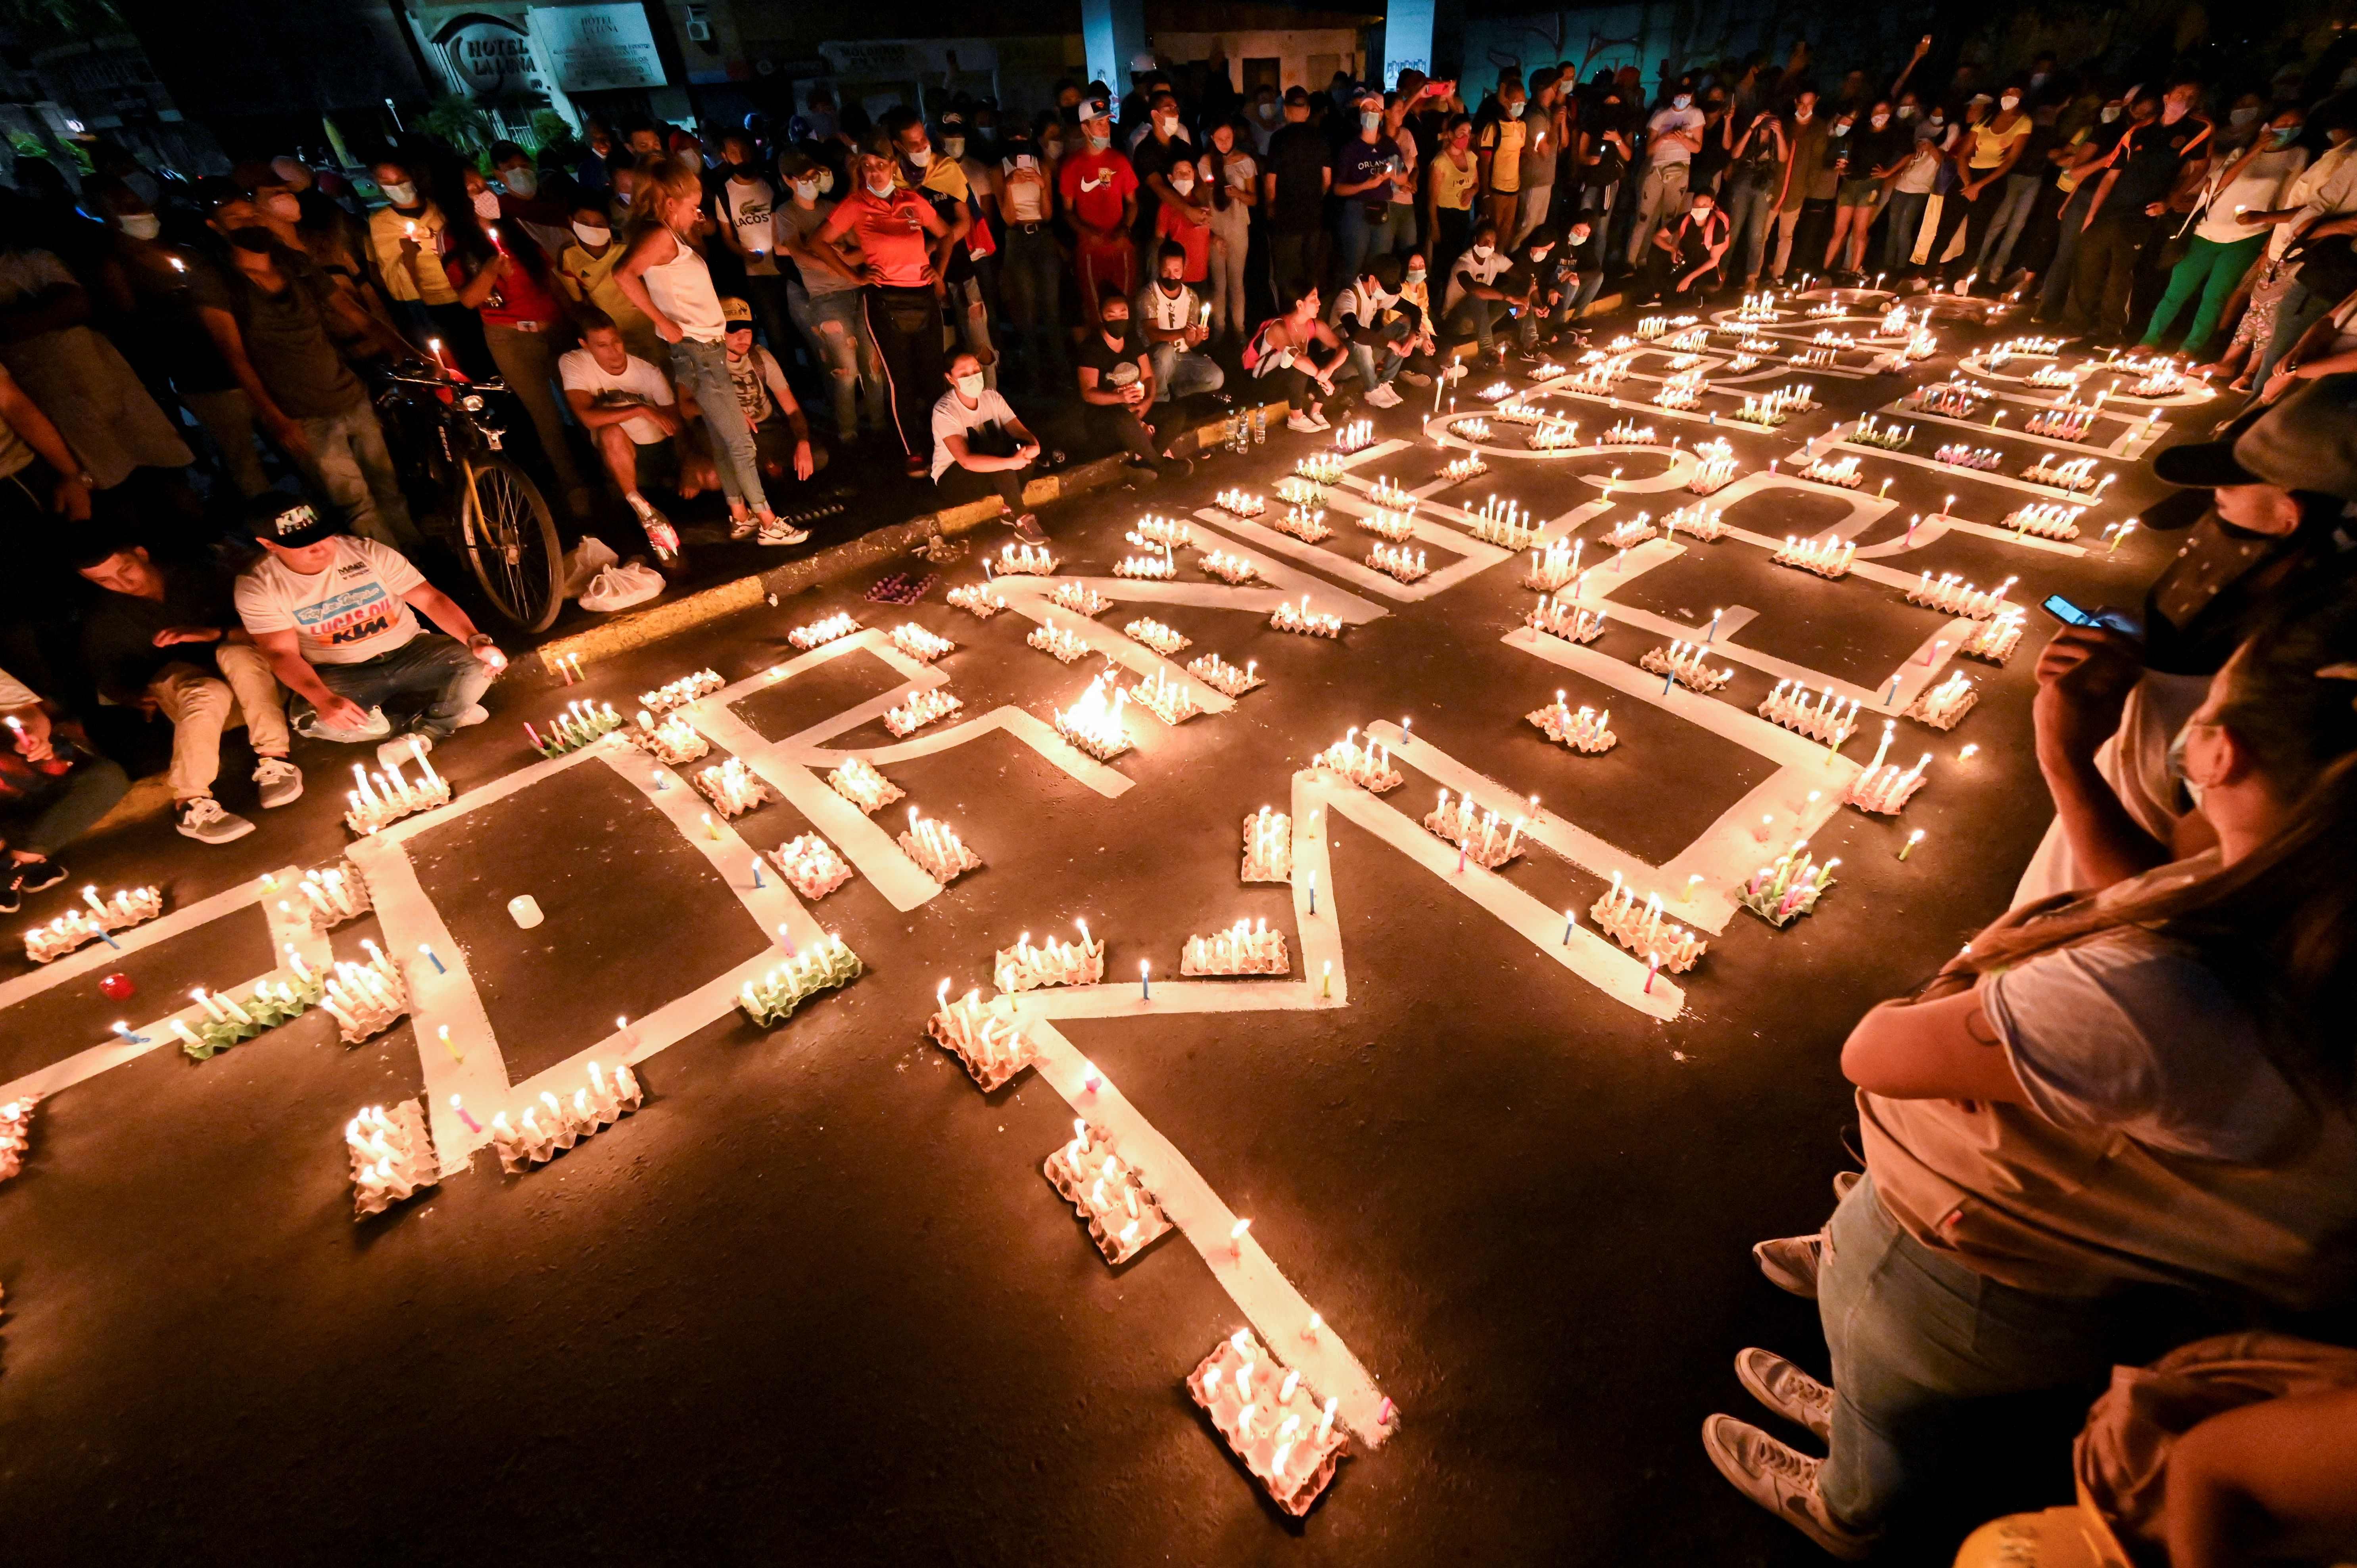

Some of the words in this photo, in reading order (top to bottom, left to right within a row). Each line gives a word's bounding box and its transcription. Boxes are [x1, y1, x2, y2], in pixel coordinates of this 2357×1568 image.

[581, 15, 611, 26] HOTEL
[467, 38, 529, 58] HOTEL
[474, 59, 495, 75] LA
[496, 56, 537, 74] LUNA
[1358, 159, 1387, 170] ORLAN
[275, 505, 317, 529] KTM
[311, 609, 365, 635] LUCAS
[369, 599, 391, 614] OIL
[332, 616, 388, 644] KTM
[992, 351, 2218, 1450] MUERTOS
